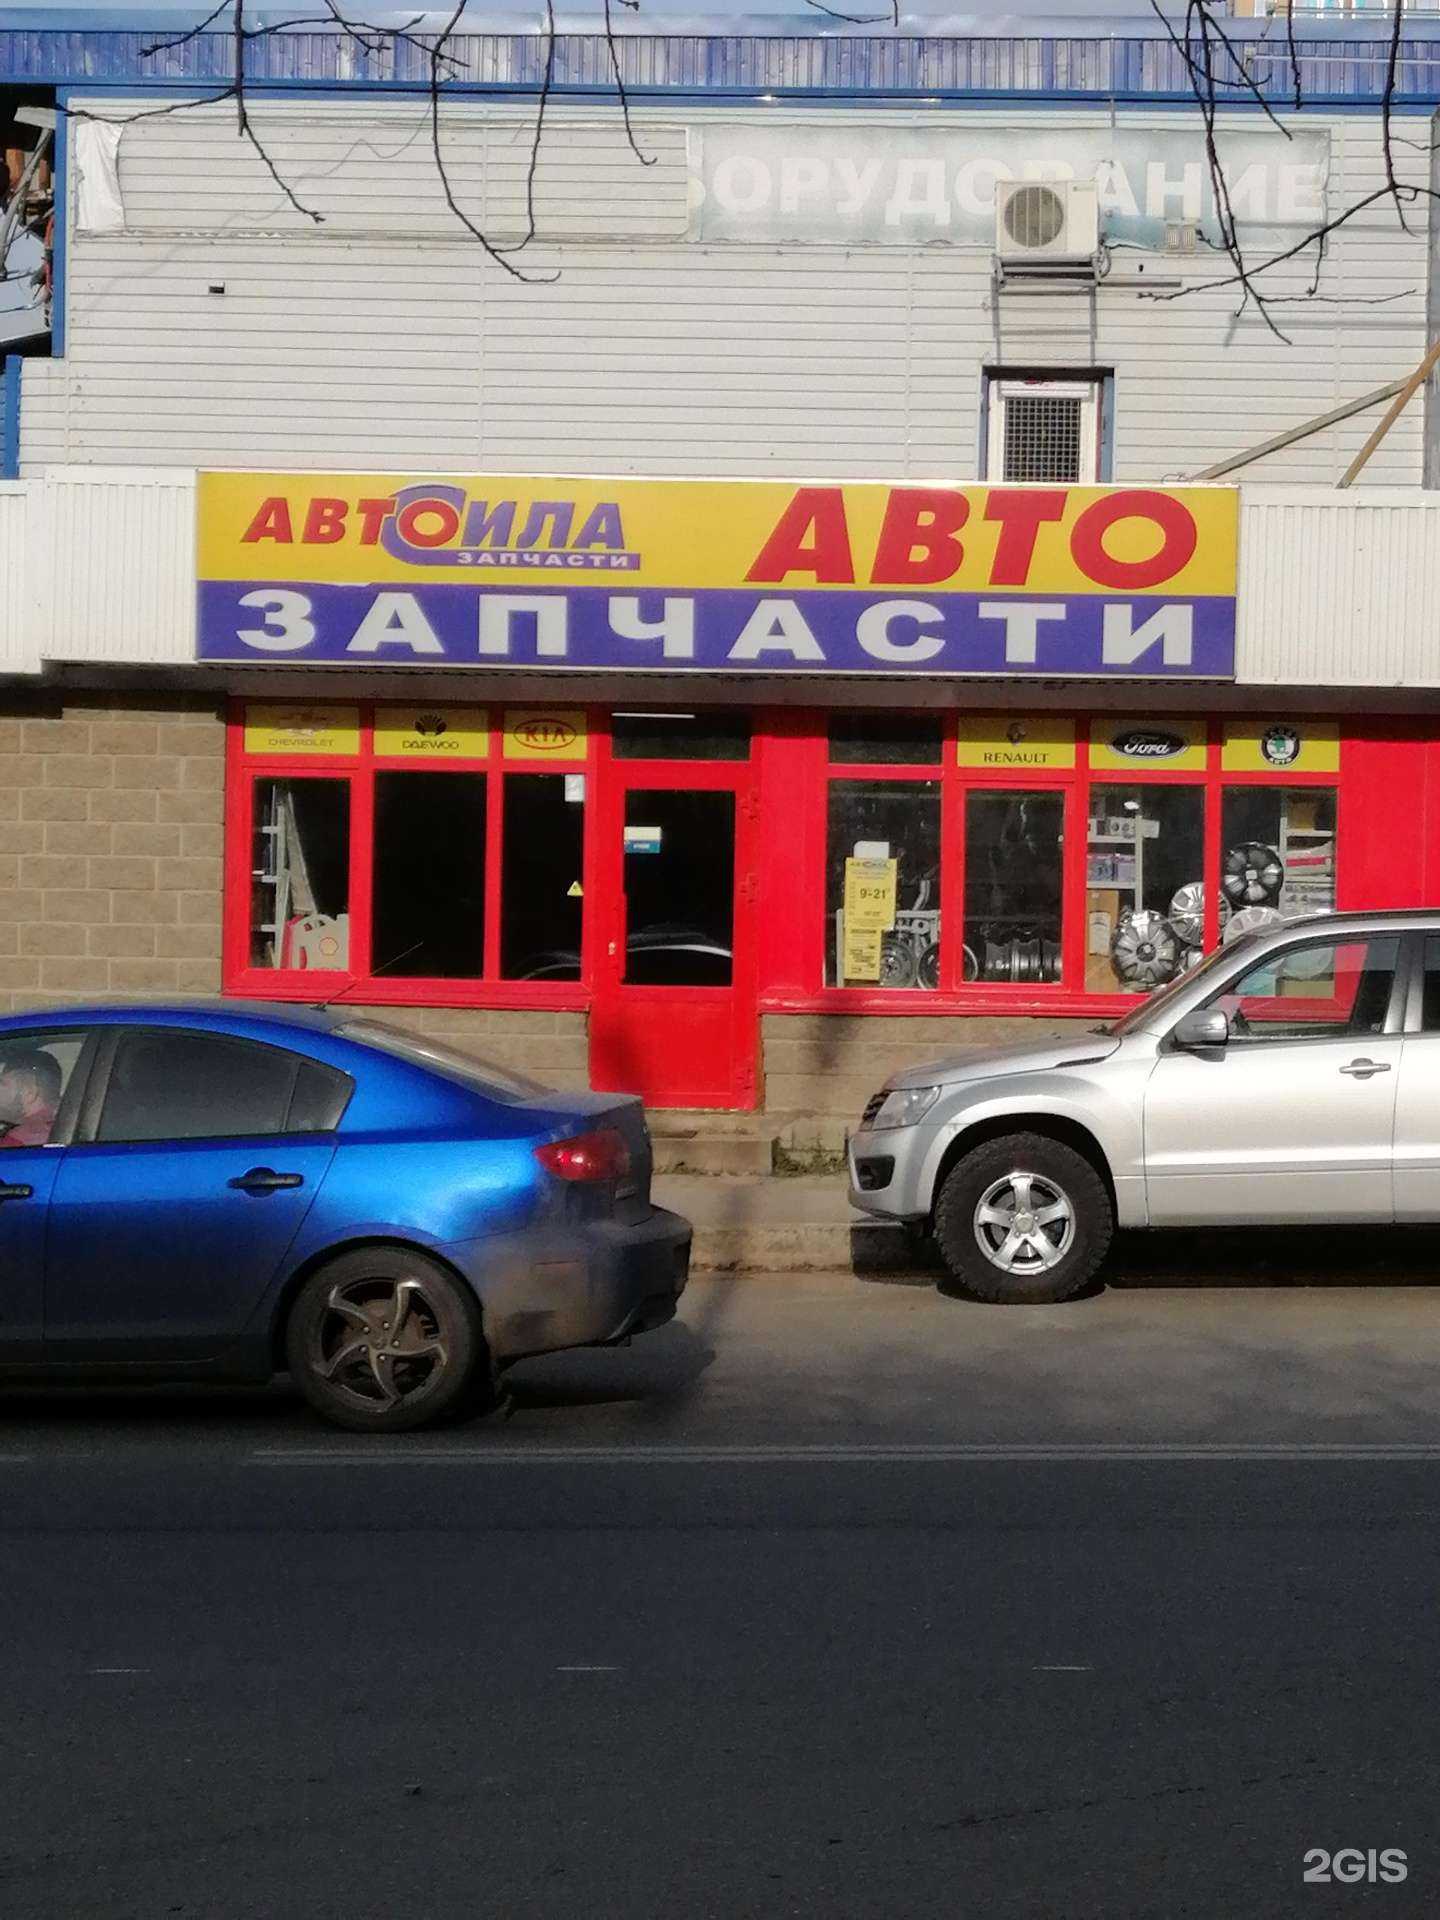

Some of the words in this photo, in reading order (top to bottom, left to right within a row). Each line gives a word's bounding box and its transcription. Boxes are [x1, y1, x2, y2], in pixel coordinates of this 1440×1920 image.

[688, 156, 1324, 226] ОРУДОАНИЕ
[743, 487, 1198, 590] АВТО
[456, 551, 629, 569] ЗАПЧАСТИ
[236, 588, 1194, 666] ЗАПЧАСТИ
[268, 738, 335, 748] CHEVROLET
[524, 726, 566, 742] KIA
[402, 739, 460, 750] DAEWOO
[1123, 734, 1170, 755] Ford
[983, 752, 1049, 764] RENAULT
